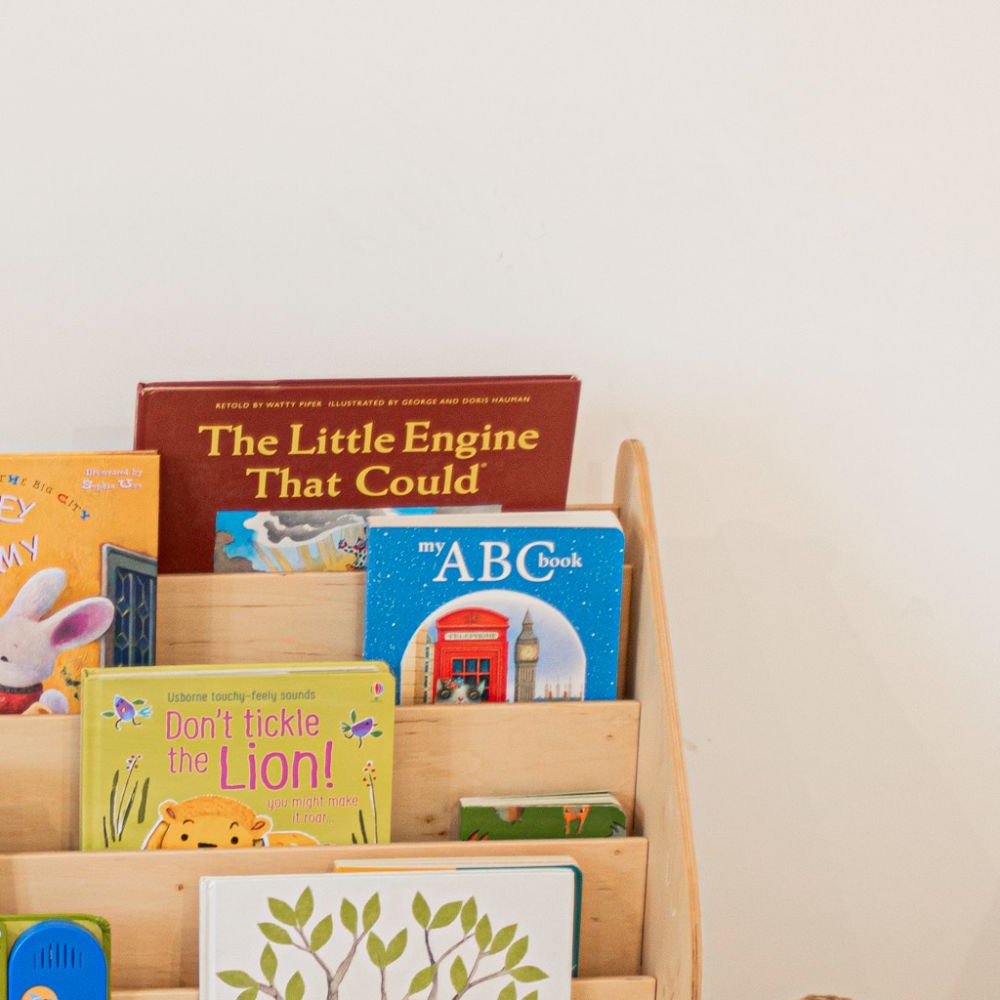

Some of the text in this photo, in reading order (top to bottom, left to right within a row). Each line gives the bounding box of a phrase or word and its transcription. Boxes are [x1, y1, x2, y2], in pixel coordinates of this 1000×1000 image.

[299, 400, 322, 408] PIPER
[328, 399, 384, 407] ILLUSTRATED
[402, 398, 437, 406] GEORGE
[491, 396, 531, 404] HAUMAN
[198, 421, 540, 460] The Little Engine
[245, 467, 342, 499] That
[57, 493, 90, 520] CITY
[418, 540, 583, 582] my ABC book
[167, 689, 316, 703] Usborne touchy-feely sounds
[166, 707, 320, 740] Don't tickle
[168, 740, 334, 790] the Lion!
[267, 794, 358, 810] you might make
[292, 812, 300, 824] it
